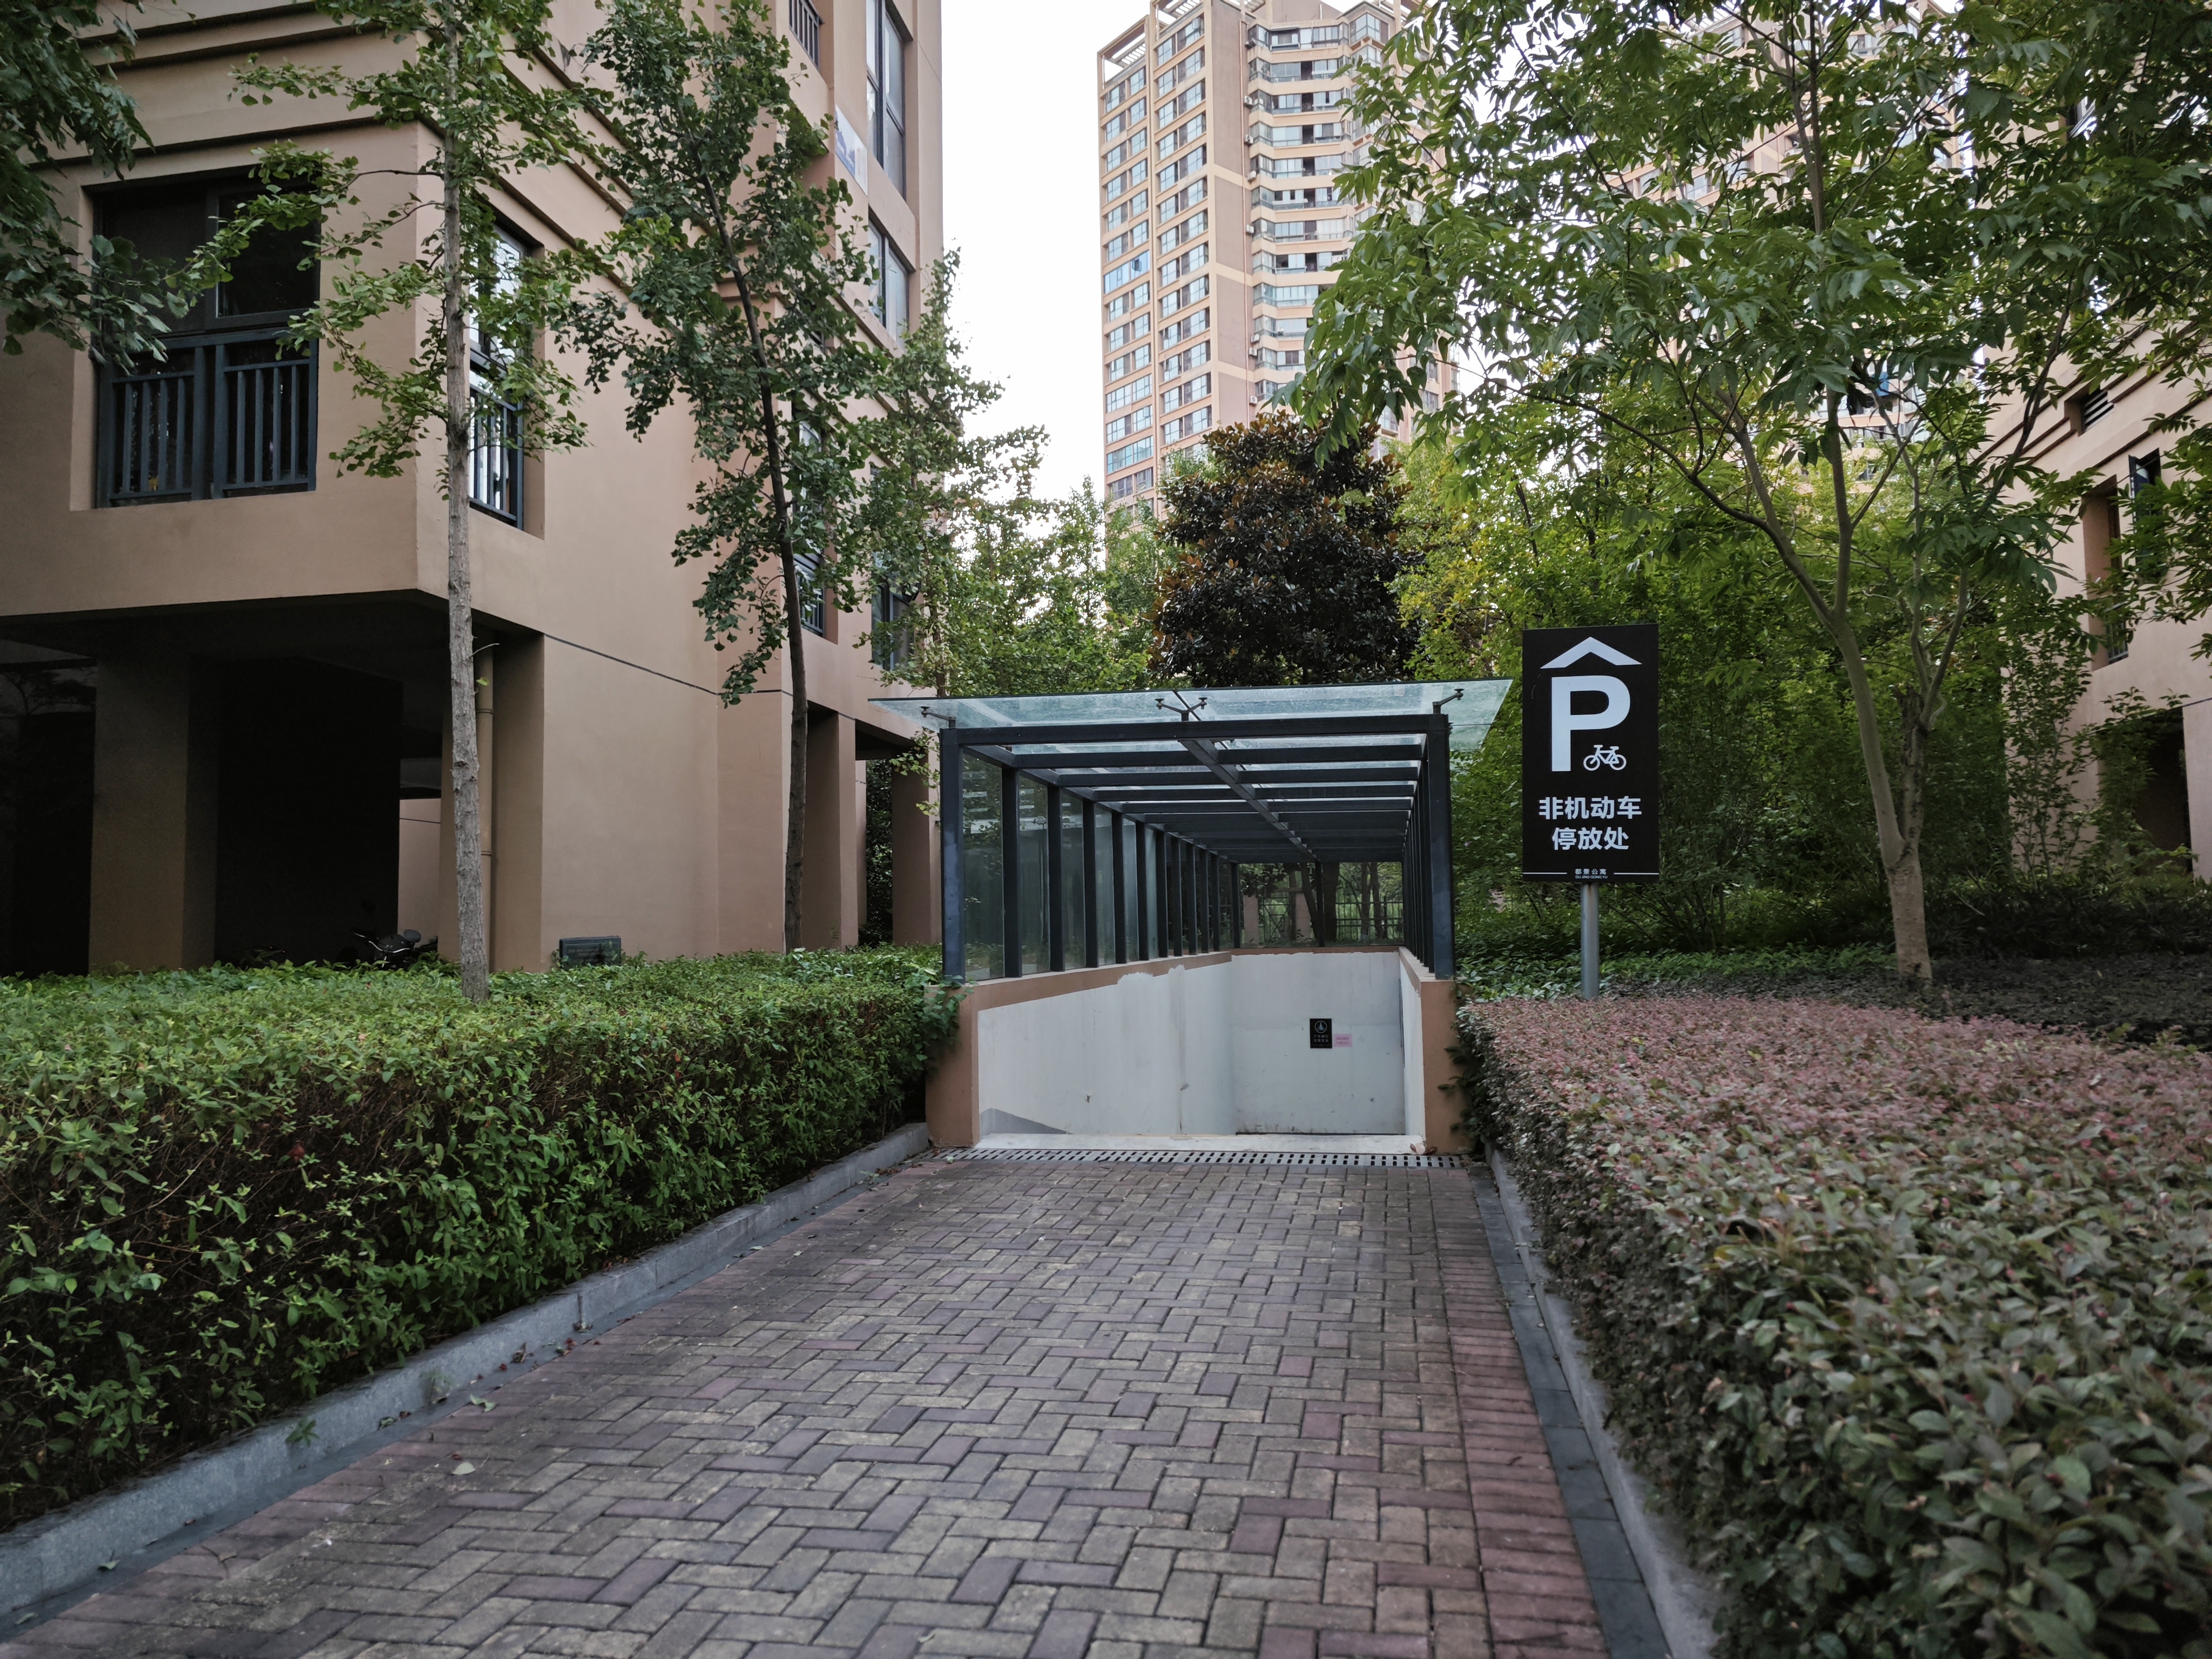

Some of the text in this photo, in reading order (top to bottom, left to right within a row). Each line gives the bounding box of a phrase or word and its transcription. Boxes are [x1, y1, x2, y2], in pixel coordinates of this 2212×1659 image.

[1551, 675, 1630, 772] P
[1539, 796, 1642, 820] 非机动车
[1552, 827, 1629, 851] 停放处
